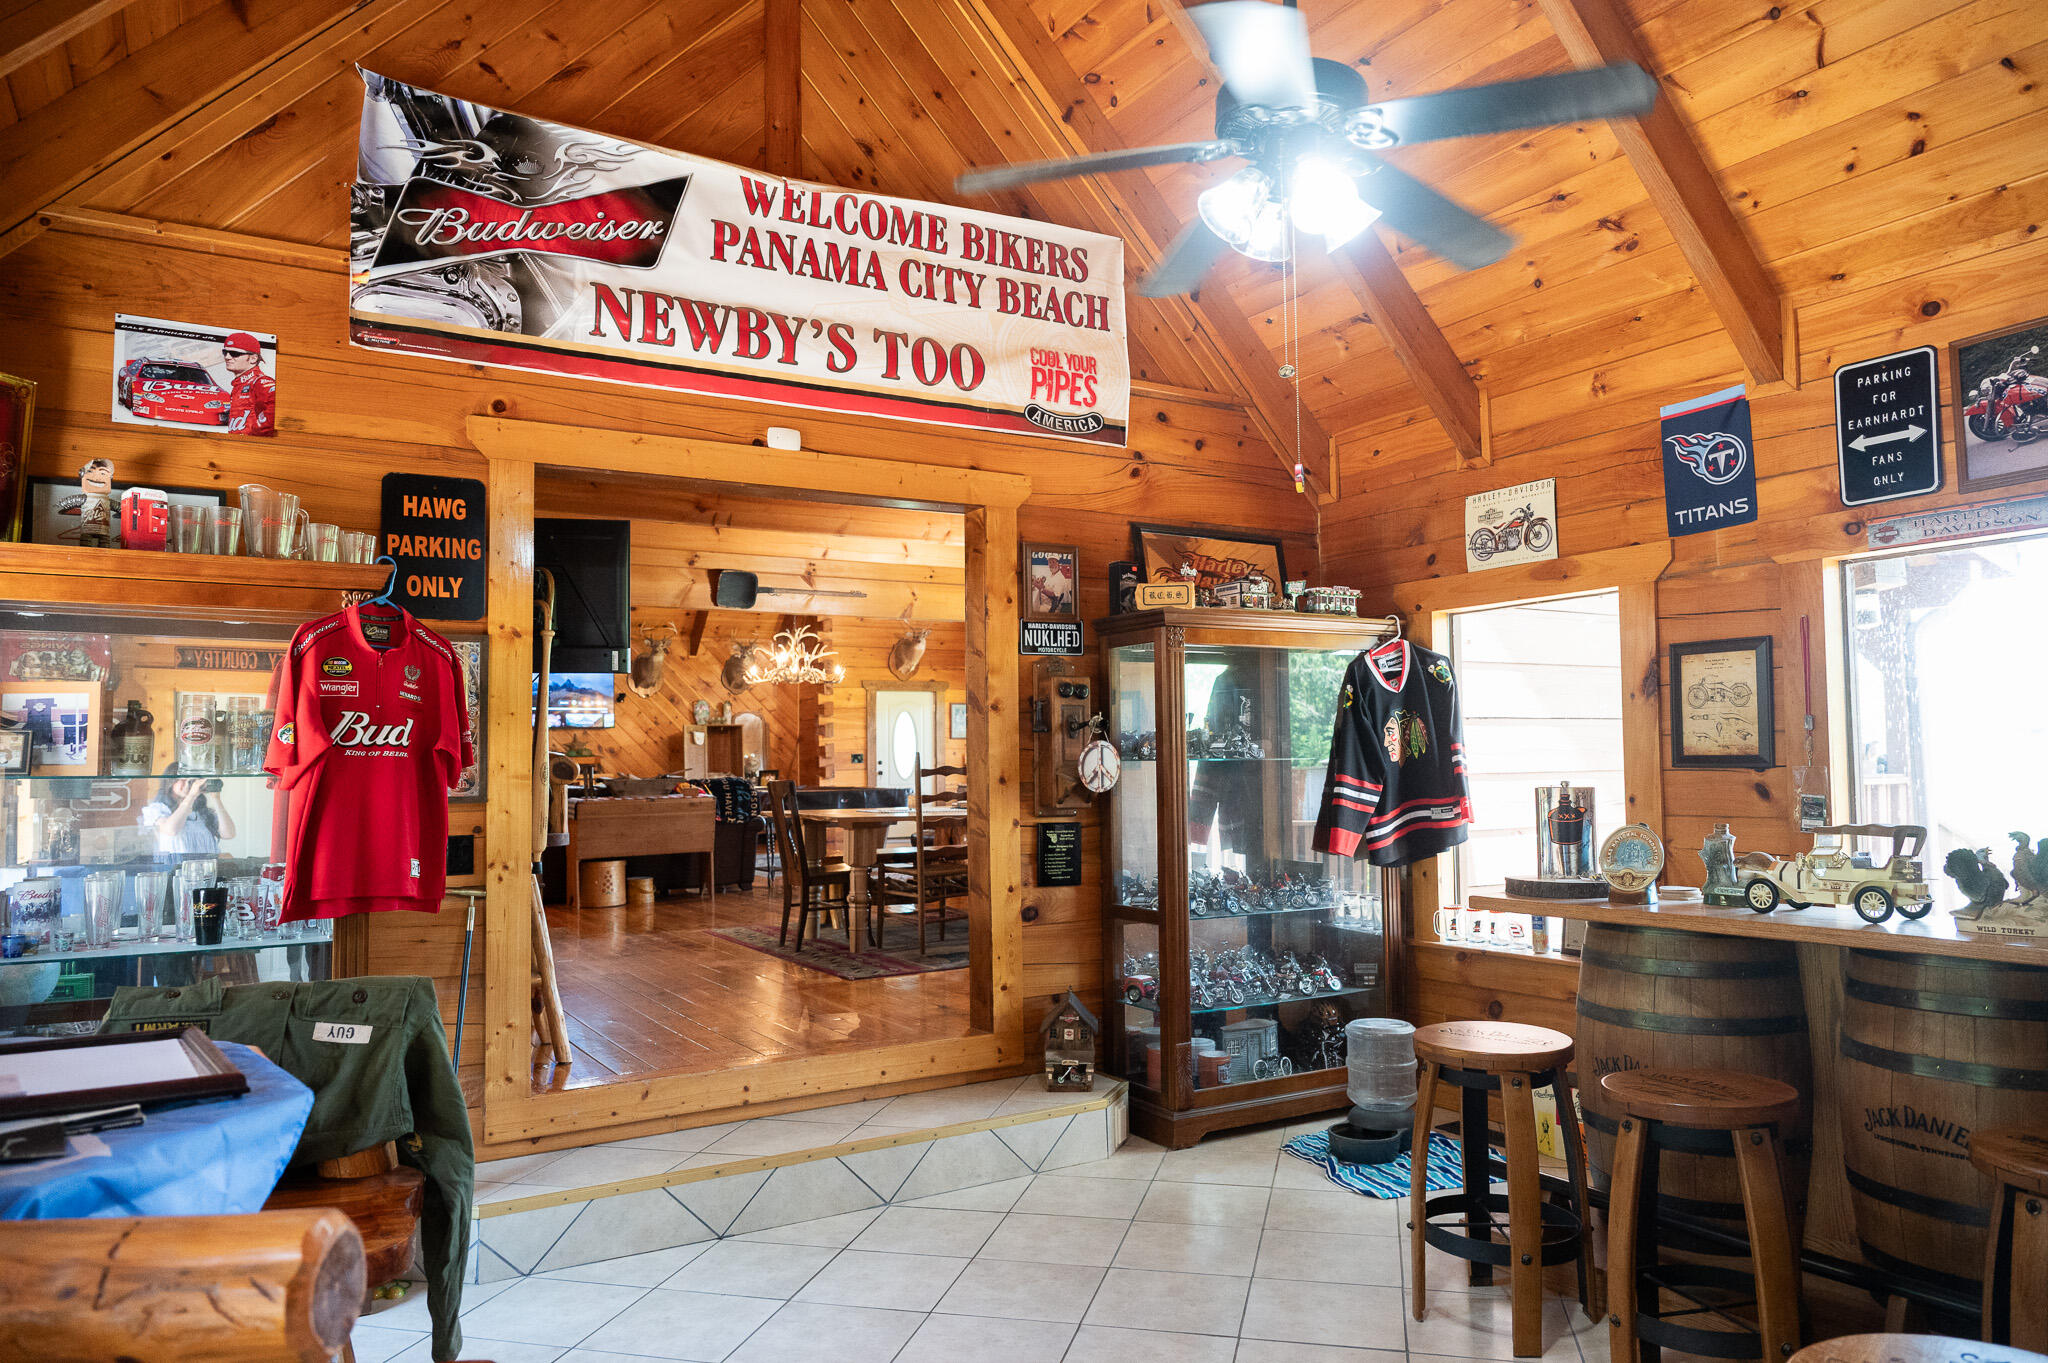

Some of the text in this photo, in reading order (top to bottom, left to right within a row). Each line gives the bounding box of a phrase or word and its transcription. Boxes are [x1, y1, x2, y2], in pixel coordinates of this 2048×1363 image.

[397, 207, 664, 247] Budweiser
[739, 175, 1089, 283] WELCOME BIKERS
[710, 219, 1111, 332] PANAMA CITY BEACH
[588, 281, 986, 392] NEWBY'S TOO
[1030, 346, 1098, 374] COOL YOUR
[142, 380, 222, 393] Bud
[1030, 367, 1098, 408] PIPES
[1856, 366, 1912, 388] PARKING
[1872, 390, 1897, 405] FOR
[228, 410, 250, 431] ud
[1031, 409, 1098, 433] AMERICA
[1848, 404, 1925, 430] EARNHARDT
[1871, 451, 1904, 466] FANS
[1873, 472, 1905, 486] ONLY
[402, 494, 467, 521] HAWG
[1674, 497, 1749, 525] TITANS
[1914, 506, 2003, 529] HARLEY
[1922, 513, 2038, 537] DAVIDSON
[386, 533, 482, 560] PARKING
[405, 575, 464, 599] ONLY
[1024, 629, 1080, 648] NUKLHED
[320, 683, 357, 695] Wrangler
[330, 710, 414, 748] Bud
[344, 749, 366, 757] KING
[367, 749, 380, 757] OF
[1976, 925, 2035, 935] WILD TURKEY
[326, 1025, 356, 1039] GUY
[1592, 1055, 1622, 1077] JACK
[1864, 1106, 1901, 1132] JACK
